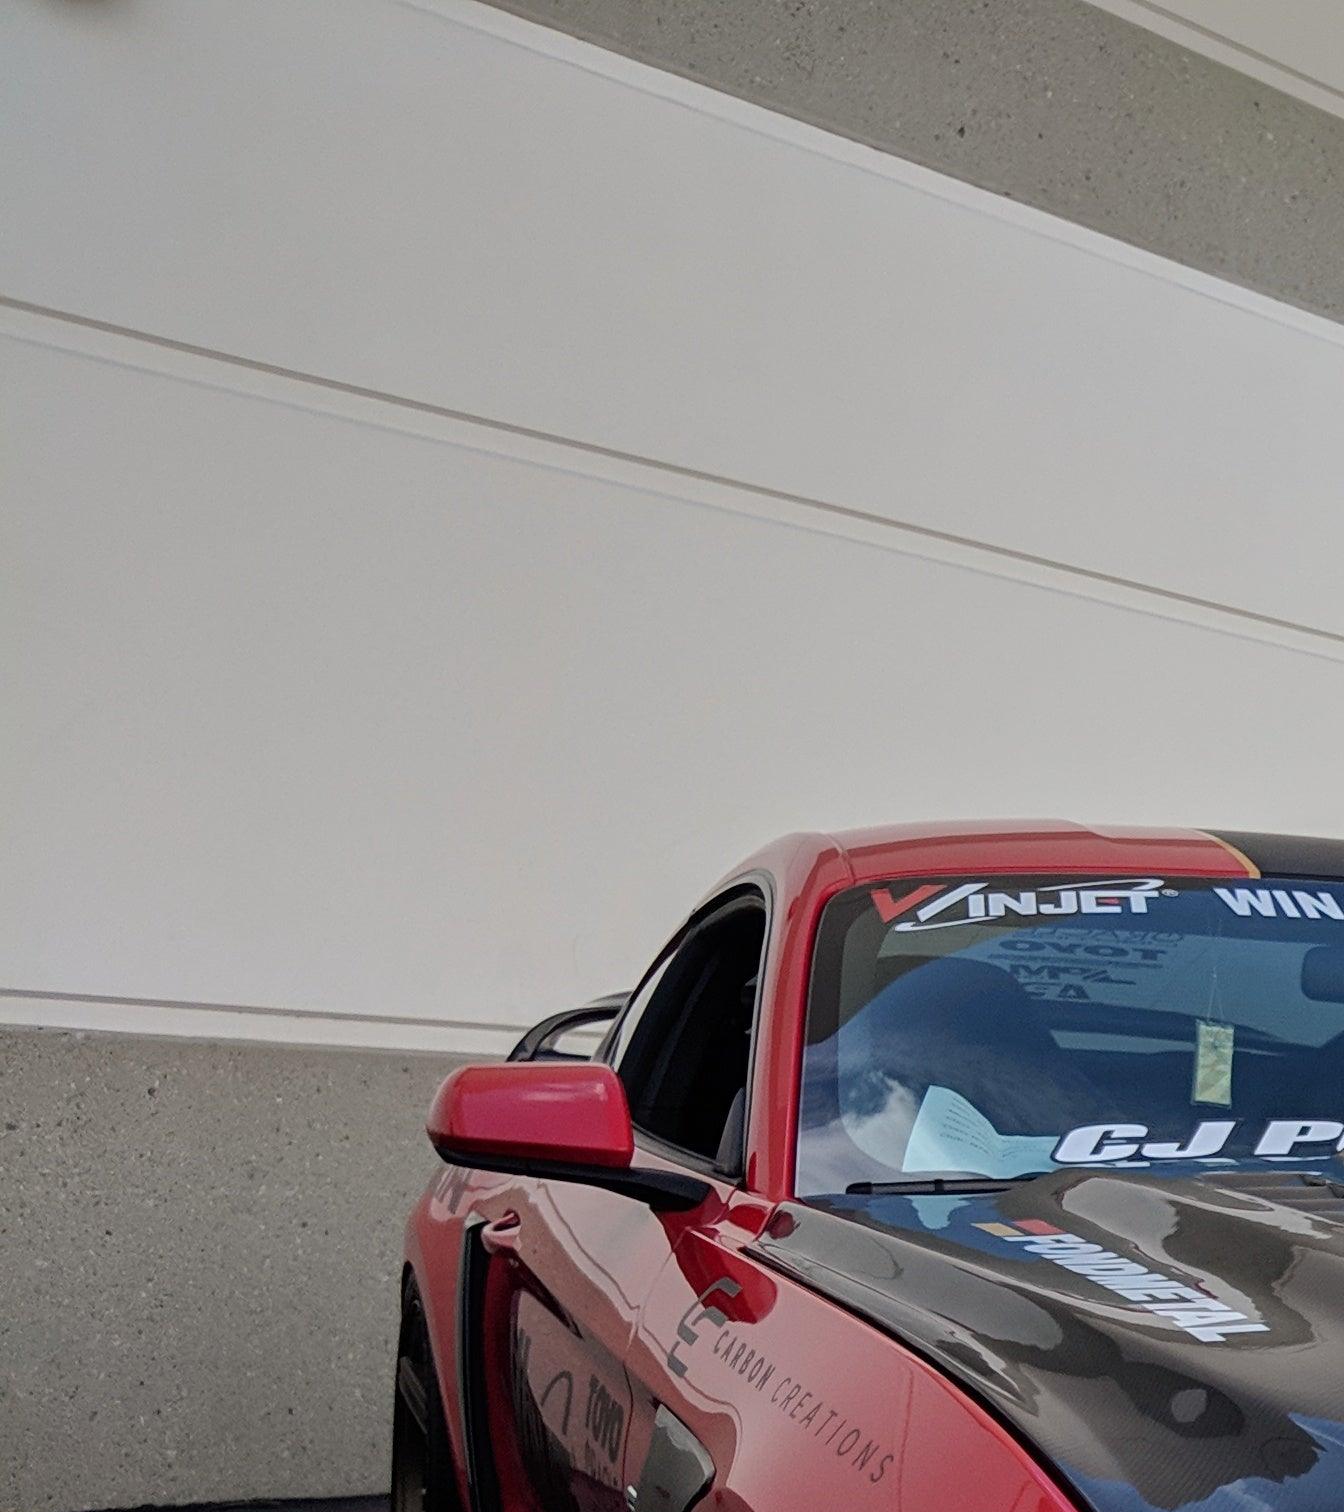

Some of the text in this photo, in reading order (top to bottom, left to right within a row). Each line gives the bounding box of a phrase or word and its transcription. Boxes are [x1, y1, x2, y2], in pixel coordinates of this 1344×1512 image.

[1055, 1120, 1237, 1163] CJ
[999, 1233, 1272, 1343] FONDMETAL
[712, 1330, 895, 1485] CARBON CREATIONS
